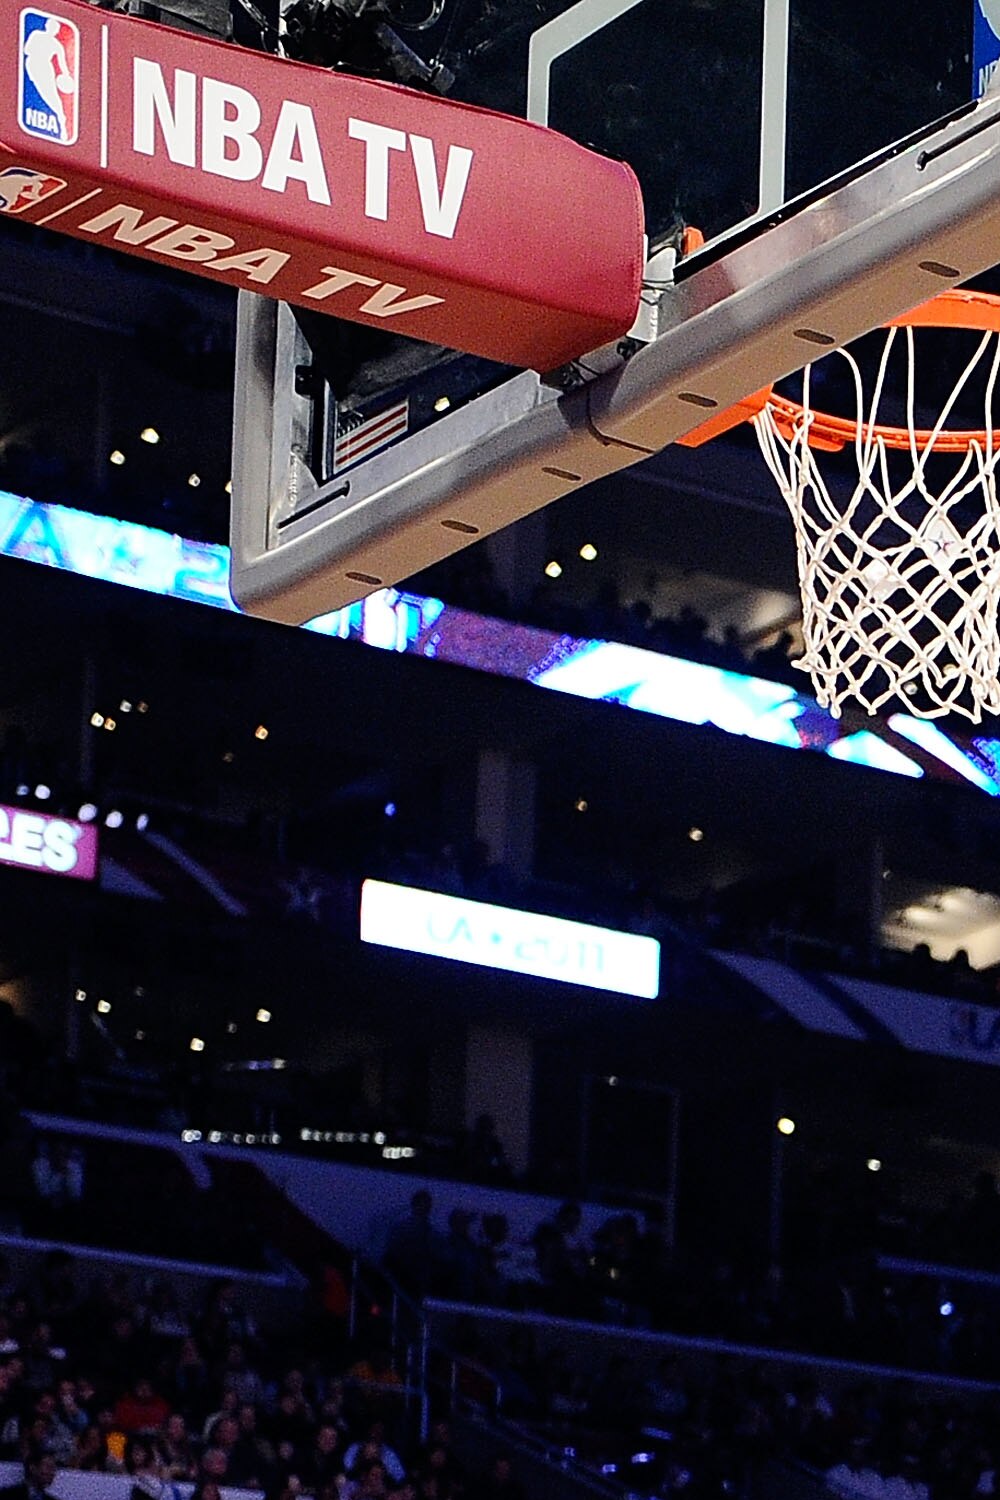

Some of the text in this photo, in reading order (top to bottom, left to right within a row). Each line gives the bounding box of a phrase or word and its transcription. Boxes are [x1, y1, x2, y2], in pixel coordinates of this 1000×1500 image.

[25, 107, 60, 134] NBA
[132, 56, 473, 239] NBA TV
[79, 203, 446, 318] NBA TV
